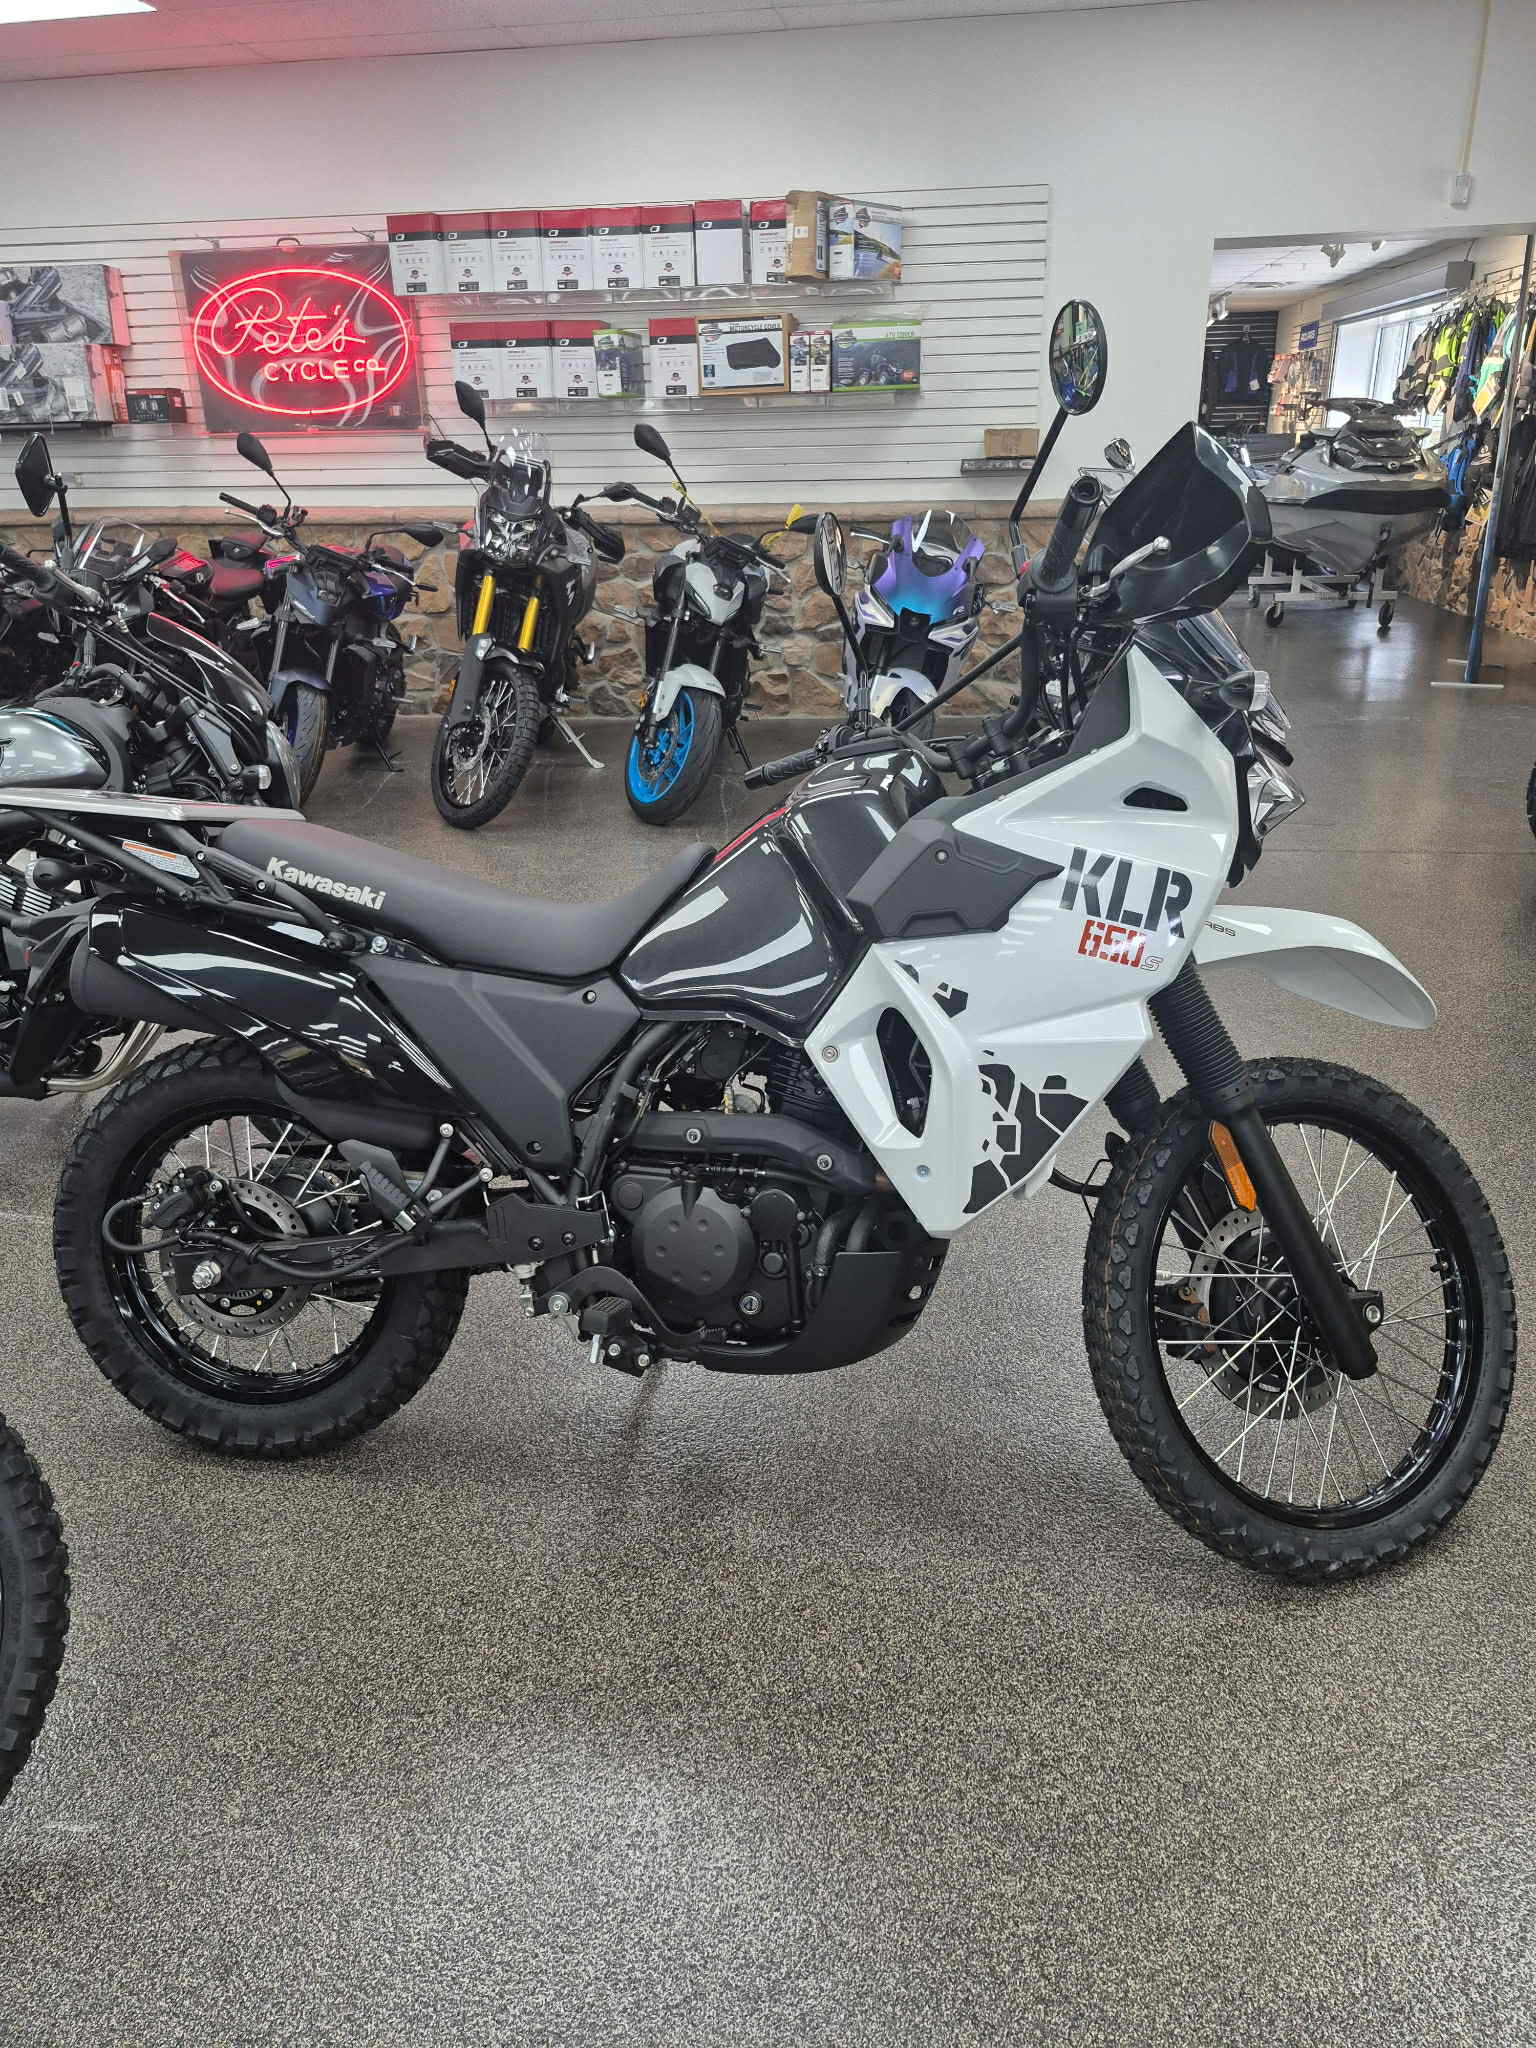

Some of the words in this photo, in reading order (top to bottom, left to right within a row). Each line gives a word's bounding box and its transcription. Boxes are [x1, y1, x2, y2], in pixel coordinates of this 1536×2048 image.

[211, 287, 367, 354] Pete's
[264, 359, 350, 382] CYCLE
[266, 856, 387, 911] Kawasaki
[1058, 846, 1193, 939] KLR
